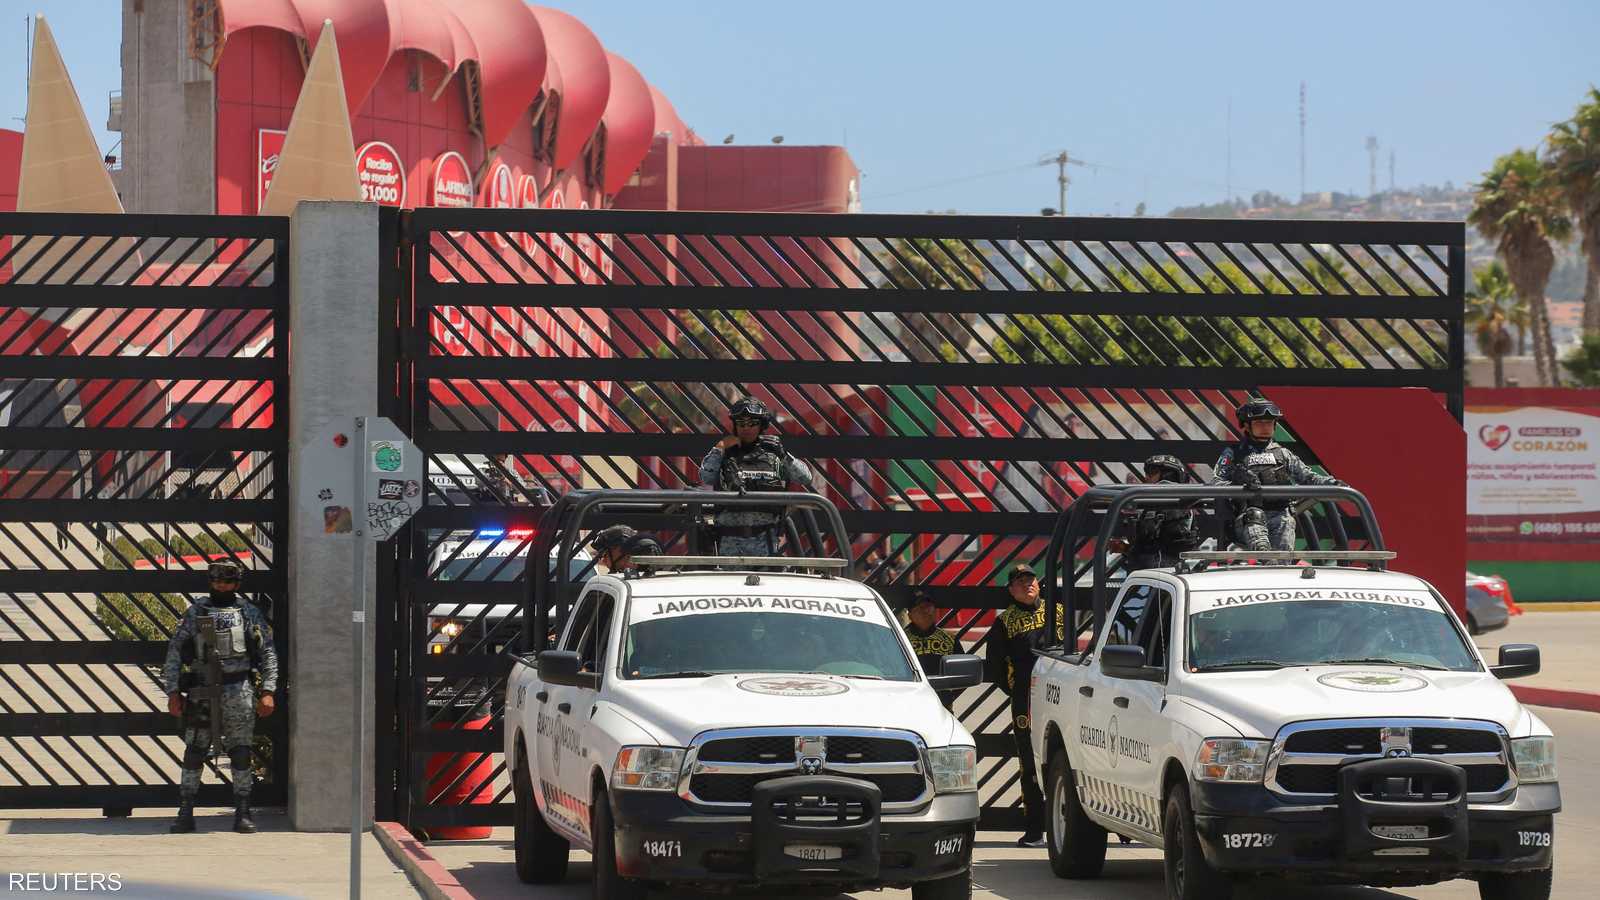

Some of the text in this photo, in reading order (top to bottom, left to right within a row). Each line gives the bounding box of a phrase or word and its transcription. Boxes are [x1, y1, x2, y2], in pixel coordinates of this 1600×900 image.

[361, 183, 398, 202] $1,000
[1513, 439, 1588, 451] CORAZÓN
[1080, 724, 1152, 763] GUARDIA NACIONAL
[934, 838, 962, 855] 18471
[1223, 833, 1273, 848] 18728
[1518, 831, 1550, 847] 18728
[643, 840, 681, 857] 18471
